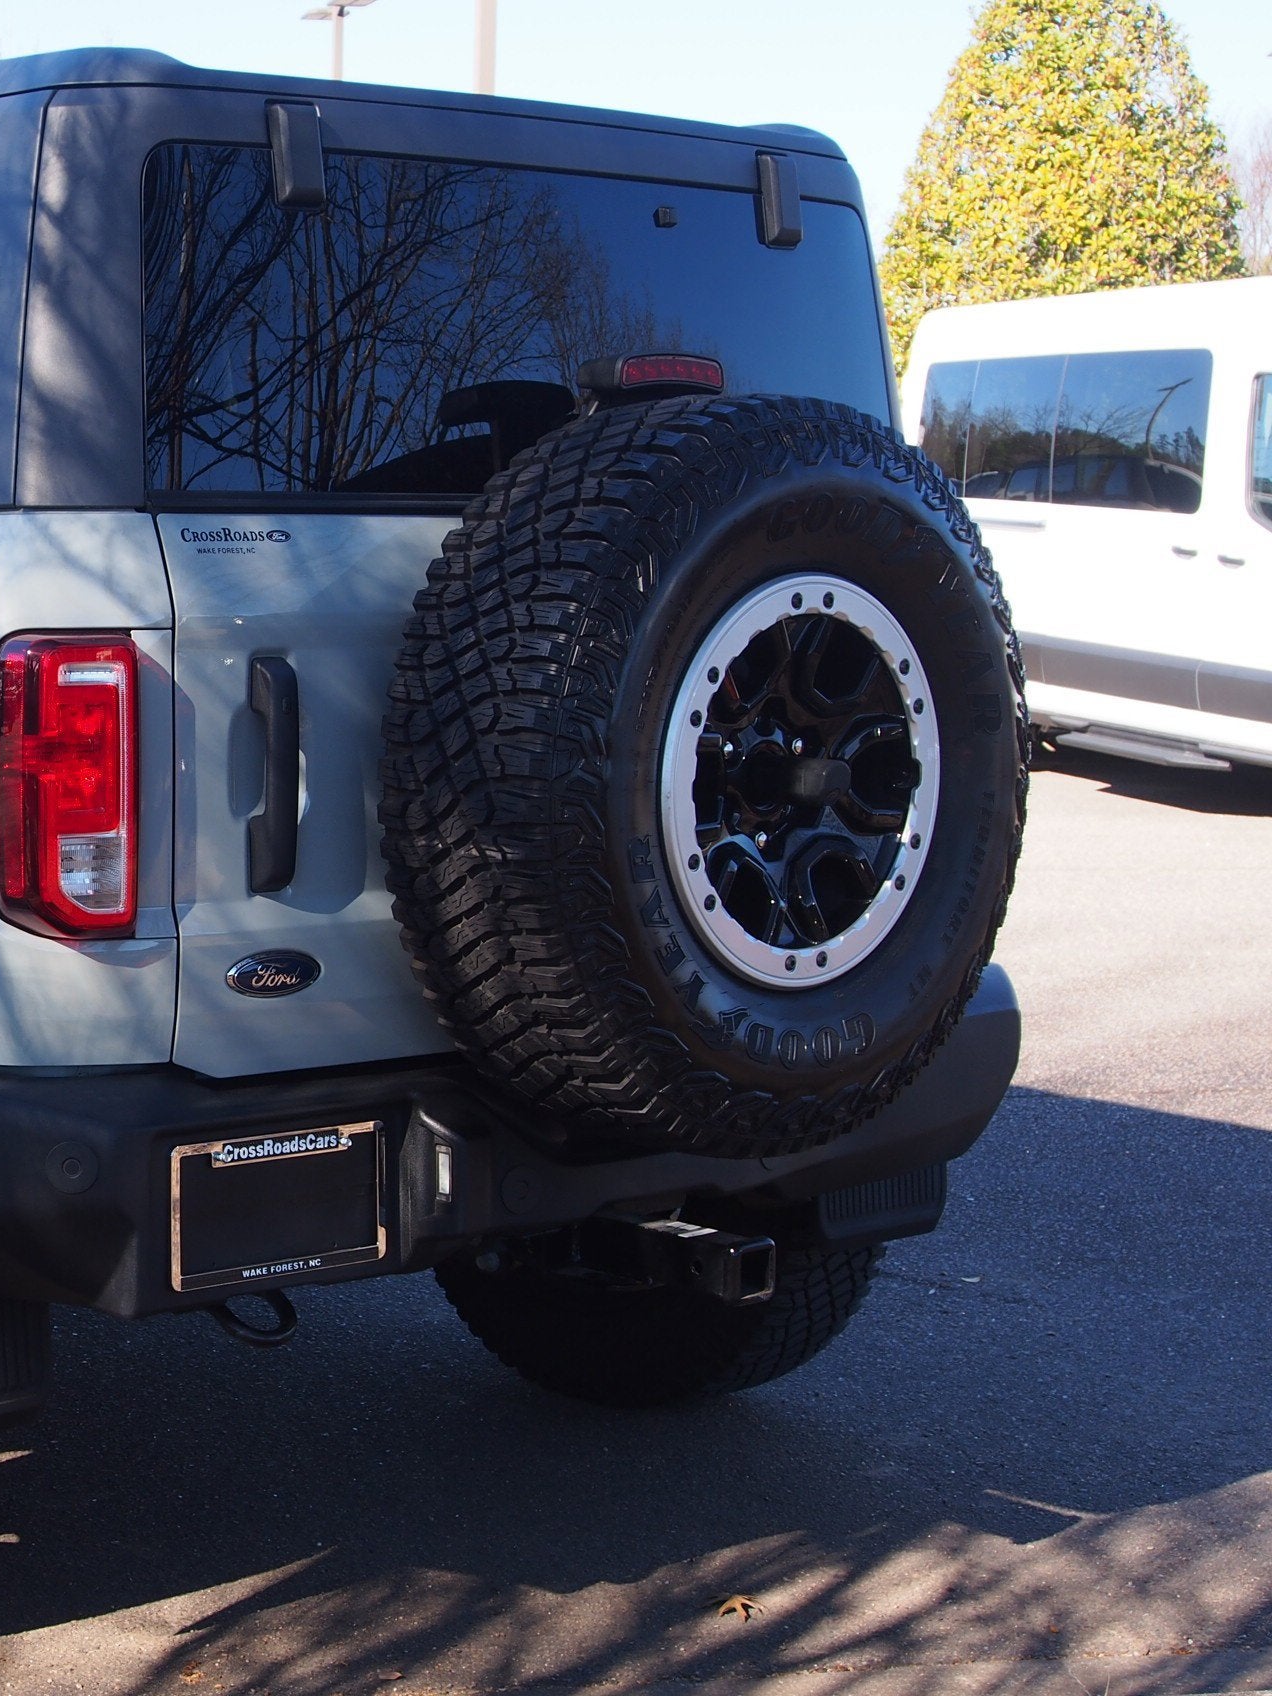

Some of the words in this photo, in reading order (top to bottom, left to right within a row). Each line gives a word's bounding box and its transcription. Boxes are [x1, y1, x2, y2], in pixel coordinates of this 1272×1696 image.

[197, 547, 216, 555] WAKE
[246, 546, 256, 554] NC
[251, 962, 301, 987] Ford
[223, 1133, 339, 1162] CrossRoadsCars
[242, 1267, 268, 1278] WAKE
[270, 1261, 307, 1274] FOREST,
[309, 1258, 322, 1268] NC
